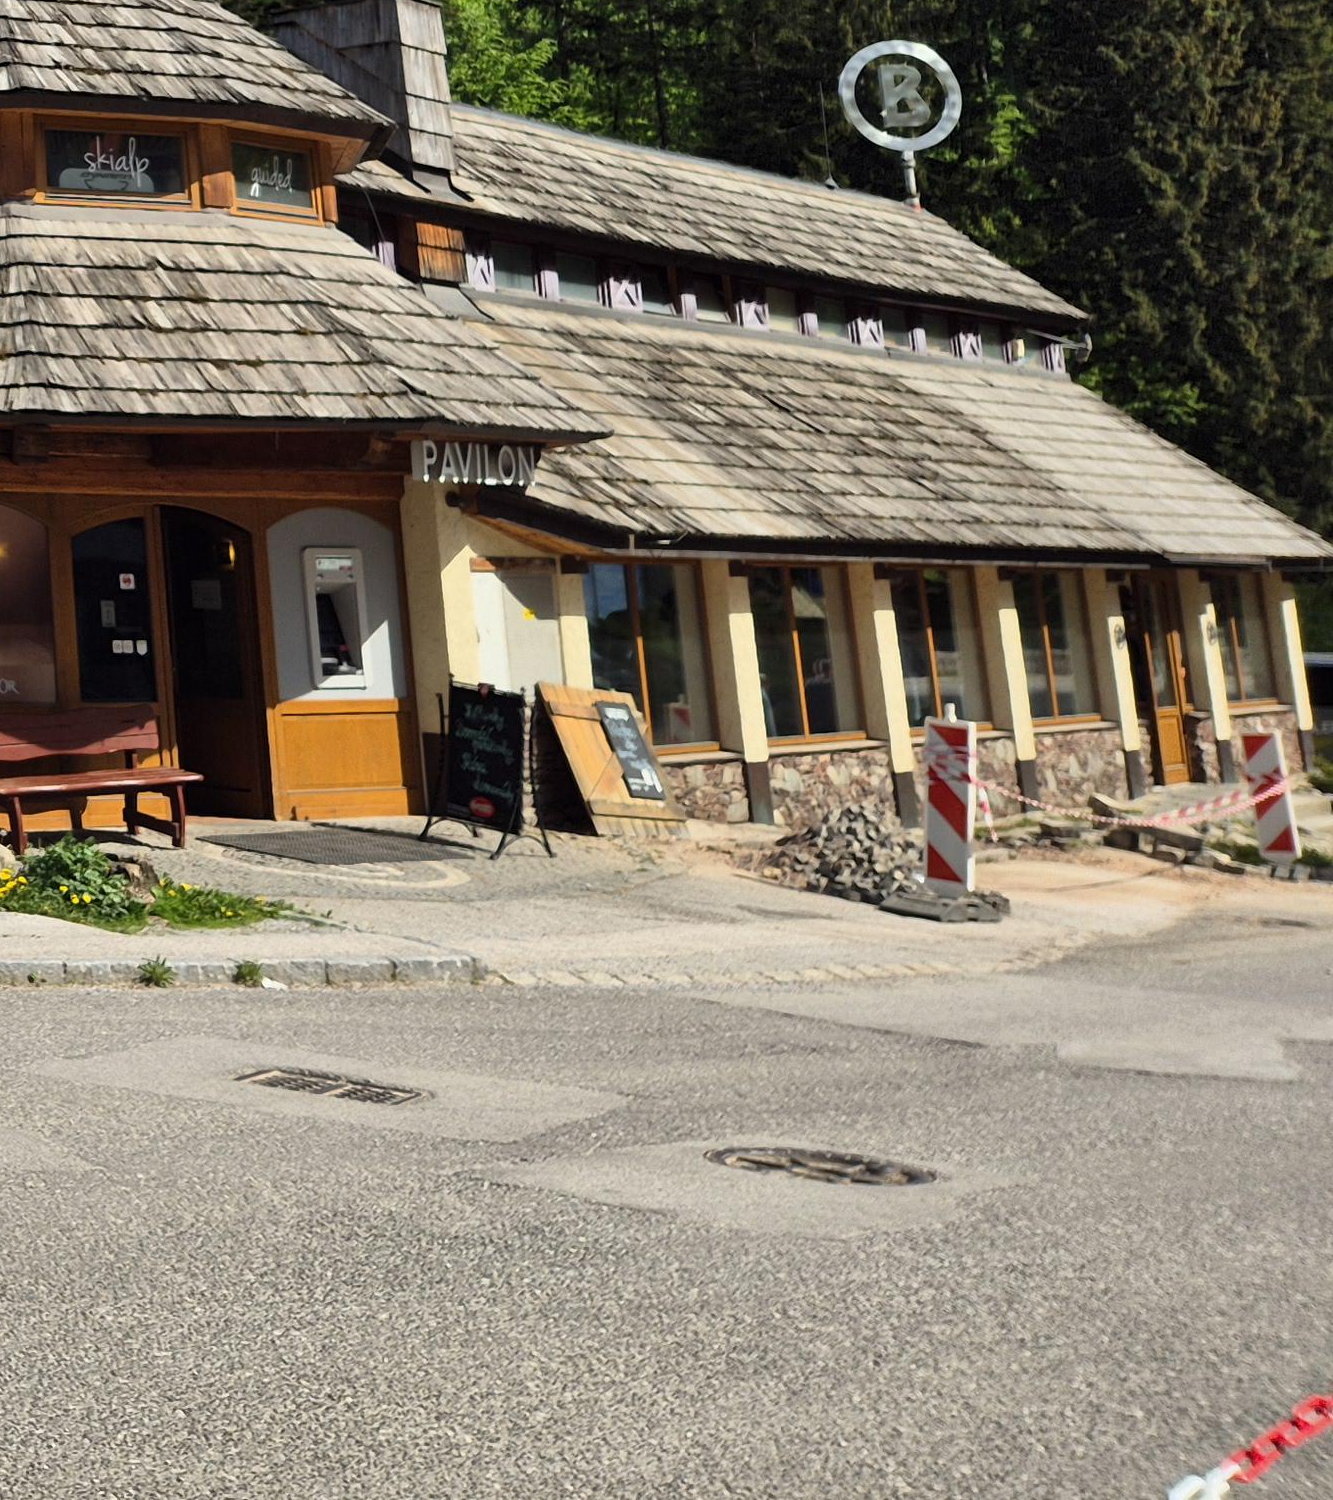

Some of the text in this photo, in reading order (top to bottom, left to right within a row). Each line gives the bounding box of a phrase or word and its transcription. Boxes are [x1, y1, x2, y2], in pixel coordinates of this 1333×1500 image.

[83, 135, 149, 188] skialp
[250, 155, 293, 197] guided
[421, 439, 536, 487] PAVILON
